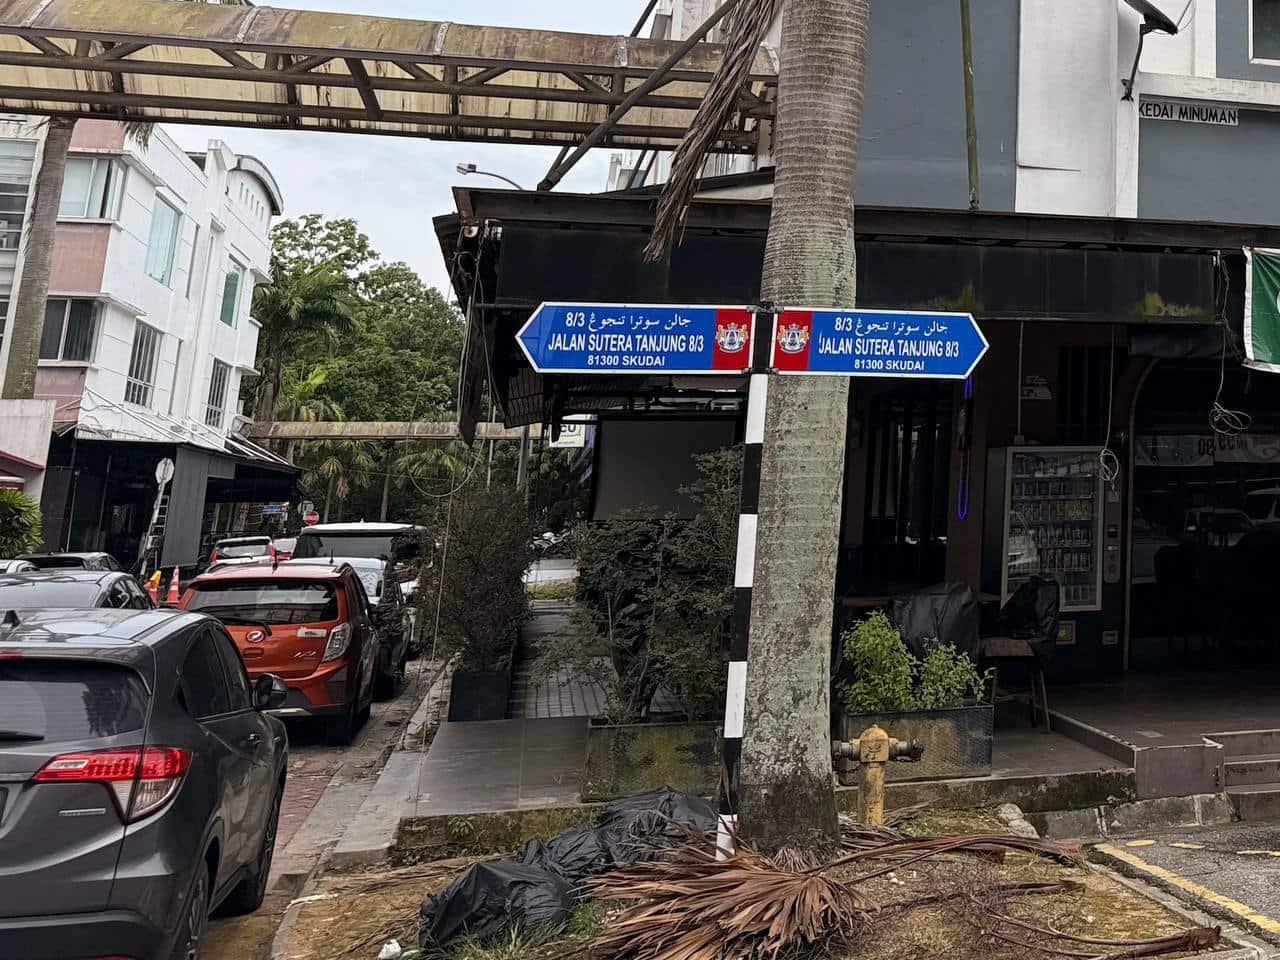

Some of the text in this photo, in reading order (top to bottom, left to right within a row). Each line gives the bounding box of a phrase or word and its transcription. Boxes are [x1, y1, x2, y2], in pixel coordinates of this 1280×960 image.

[1139, 102, 1237, 124] KEDAI MINUMAN
[565, 311, 585, 328] 8/3
[834, 317, 853, 331] 8/3
[548, 333, 704, 353] JALAN SUTERA TANJUNG 8/3
[818, 336, 959, 358] JALAN SUTERA TANJUNG 8/3
[587, 355, 665, 366] 81300 SKUDAI
[854, 359, 925, 370] 81300 SKUDAI
